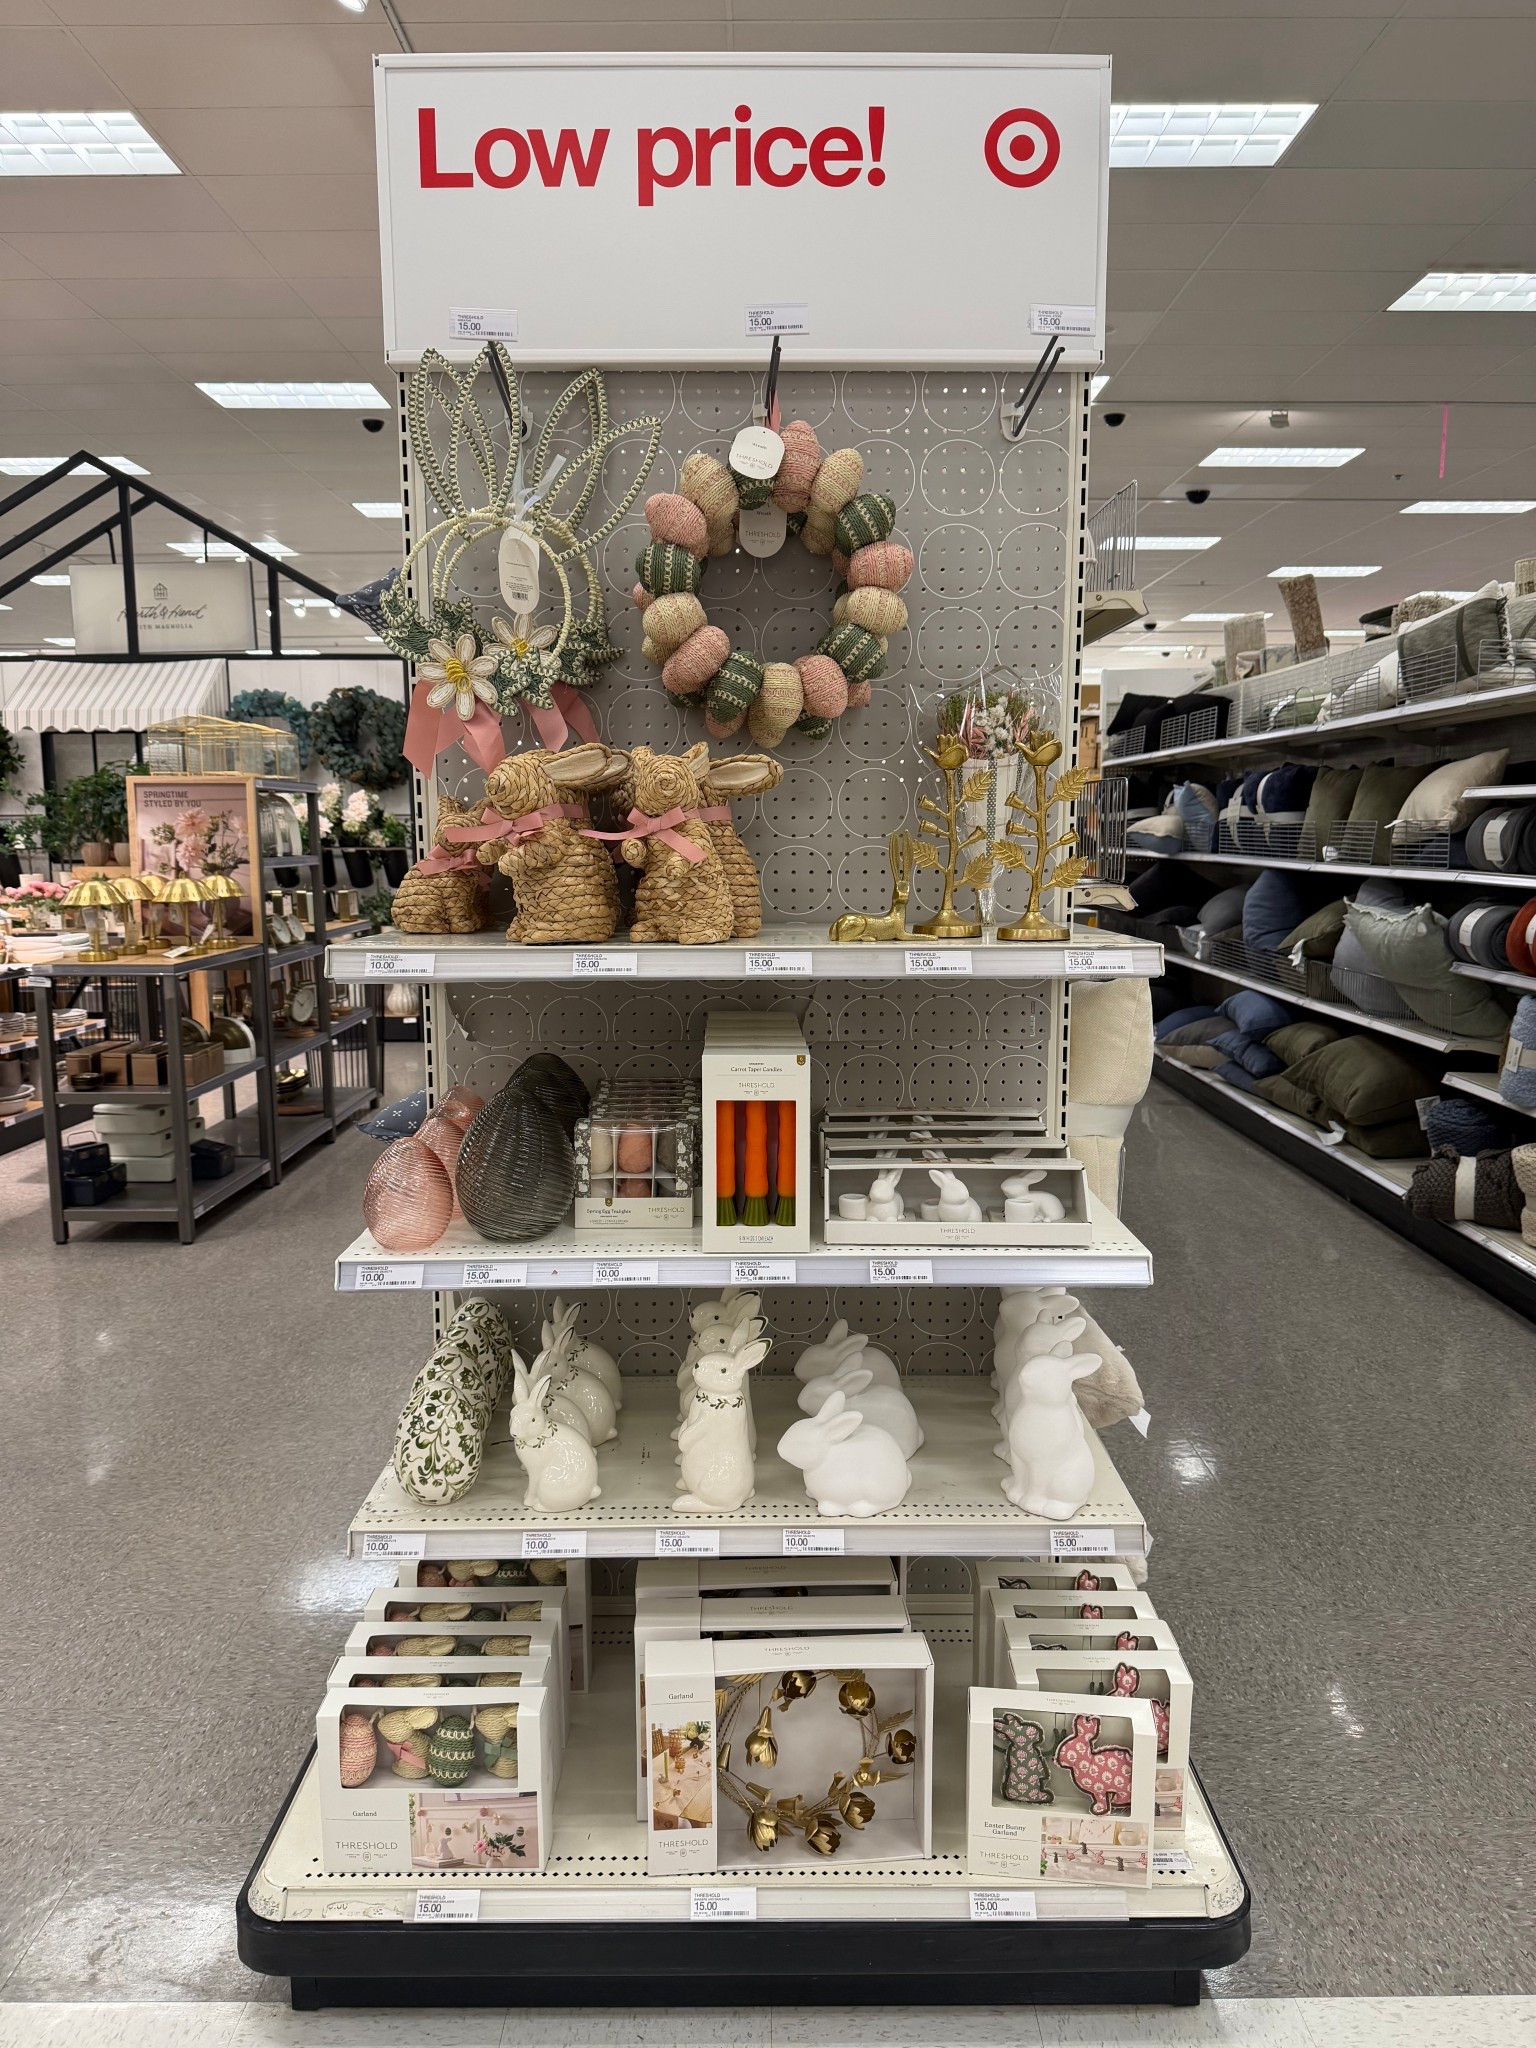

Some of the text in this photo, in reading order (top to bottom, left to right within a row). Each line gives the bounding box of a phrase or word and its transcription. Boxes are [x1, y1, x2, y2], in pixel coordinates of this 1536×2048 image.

[417, 103, 886, 207] Low price!
[750, 318, 772, 326] 15.00
[1039, 318, 1061, 326] 15.00
[458, 322, 481, 331] 15.00
[736, 454, 772, 468] THRESHOLD
[160, 606, 169, 620] &
[168, 604, 207, 620] Hand
[370, 962, 394, 970] 10.00
[874, 1268, 896, 1276] 15.00
[526, 1541, 548, 1549] 10.00
[336, 1842, 398, 1850] THRESHOLD
[658, 1839, 708, 1848] THRESHOLD
[979, 1851, 1029, 1861] THRESHOLD
[418, 1904, 442, 1912] 15.00
[696, 1902, 717, 1910] 15.00
[976, 1902, 998, 1910] 15.00
